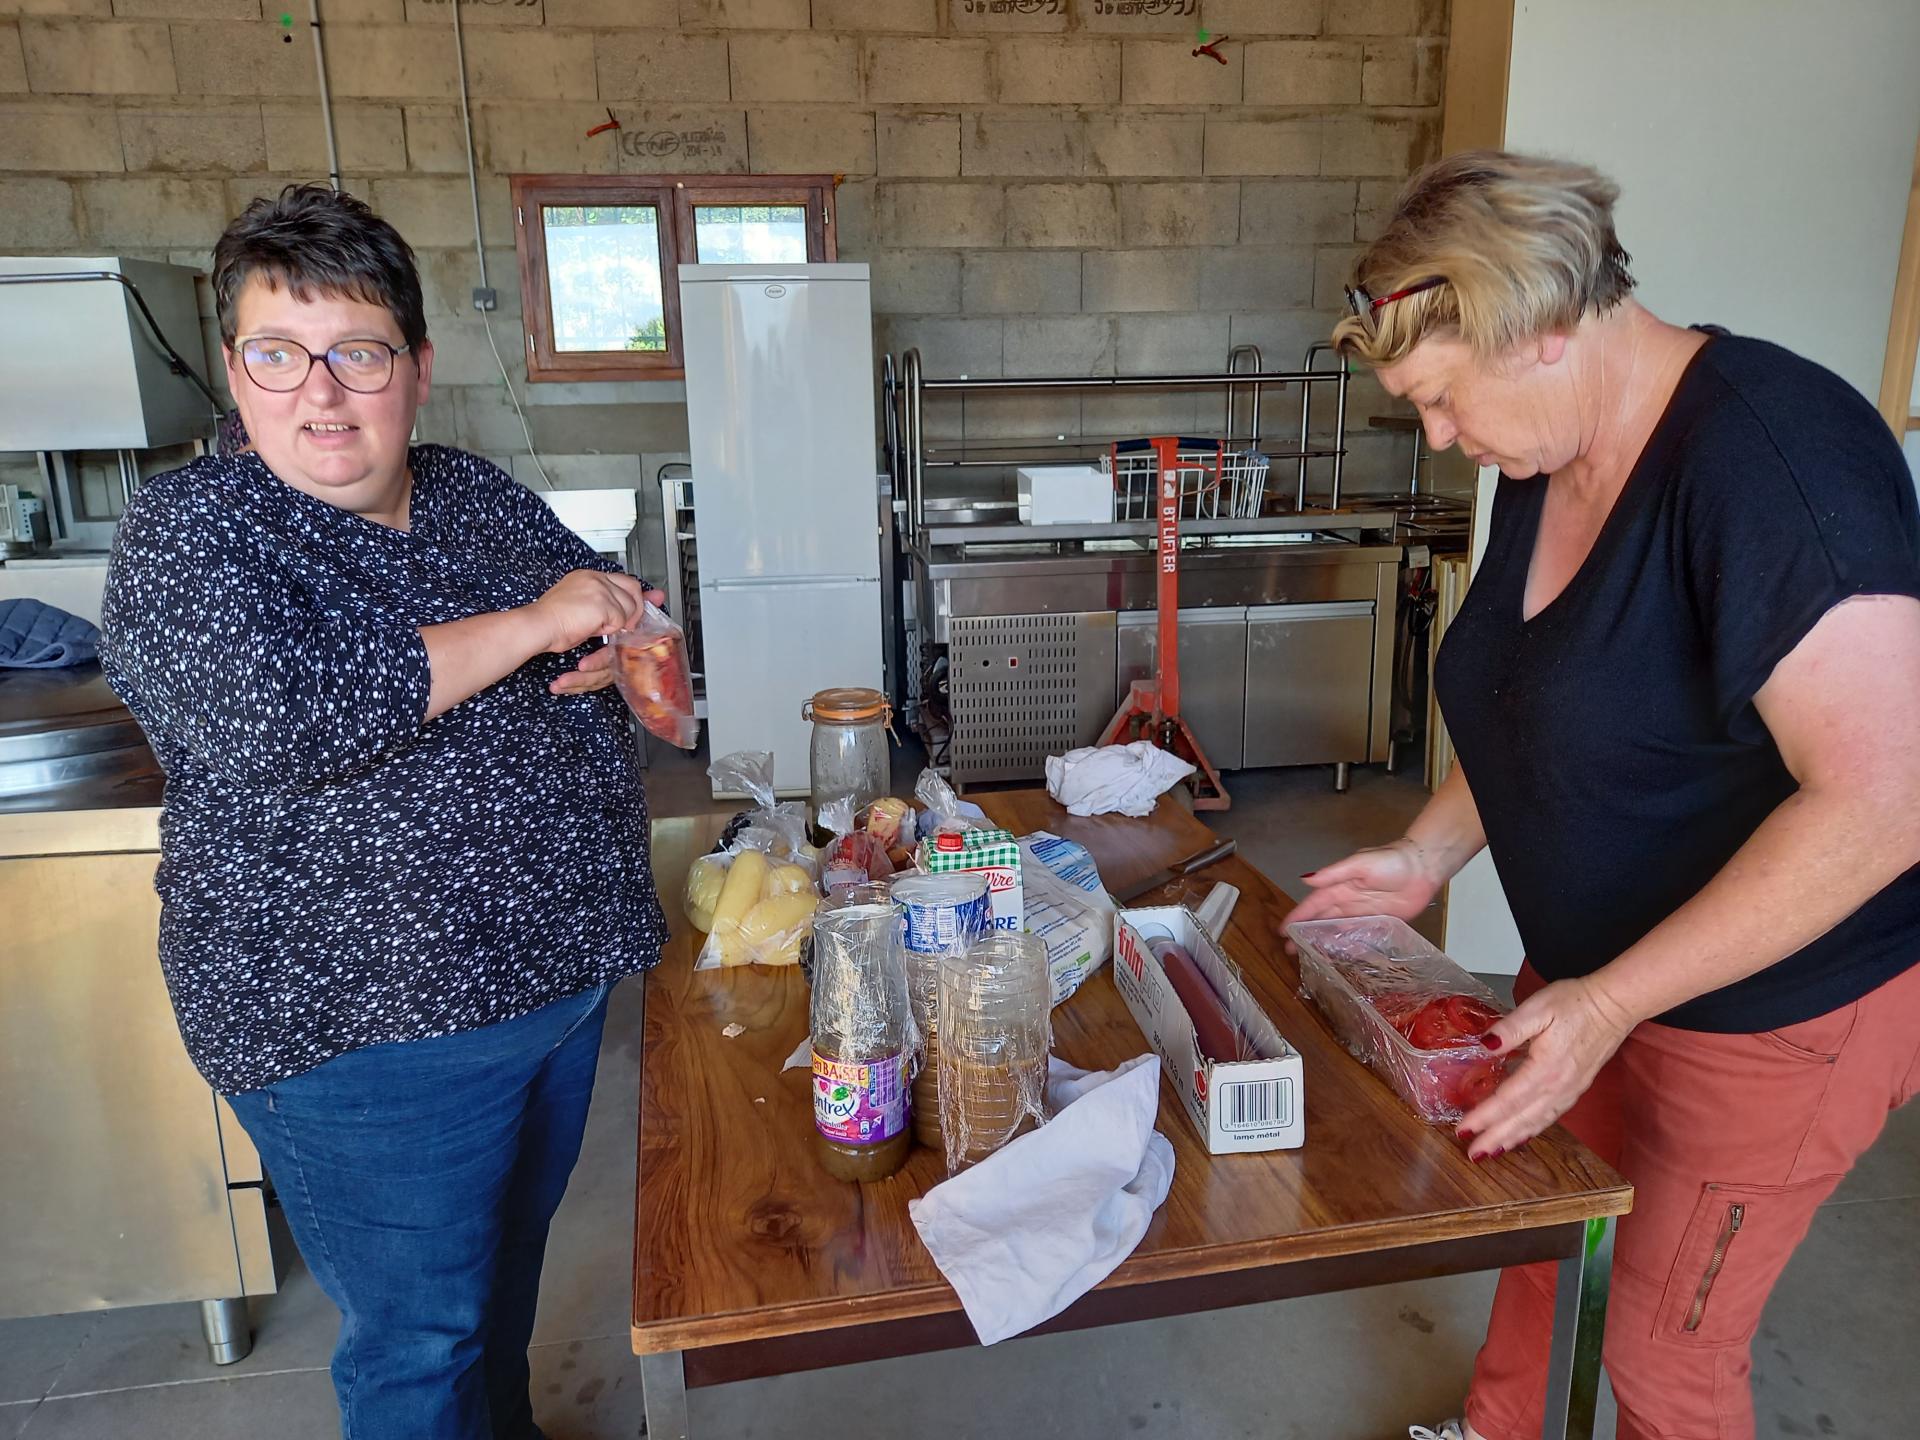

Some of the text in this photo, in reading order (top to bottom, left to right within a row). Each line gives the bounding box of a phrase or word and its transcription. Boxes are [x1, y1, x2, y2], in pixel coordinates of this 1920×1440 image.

[650, 137, 676, 151] NF
[1163, 507, 1176, 524] BT
[984, 872, 1014, 887] Vire
[1118, 924, 1145, 982] film
[1234, 1130, 1280, 1141] lame métal
